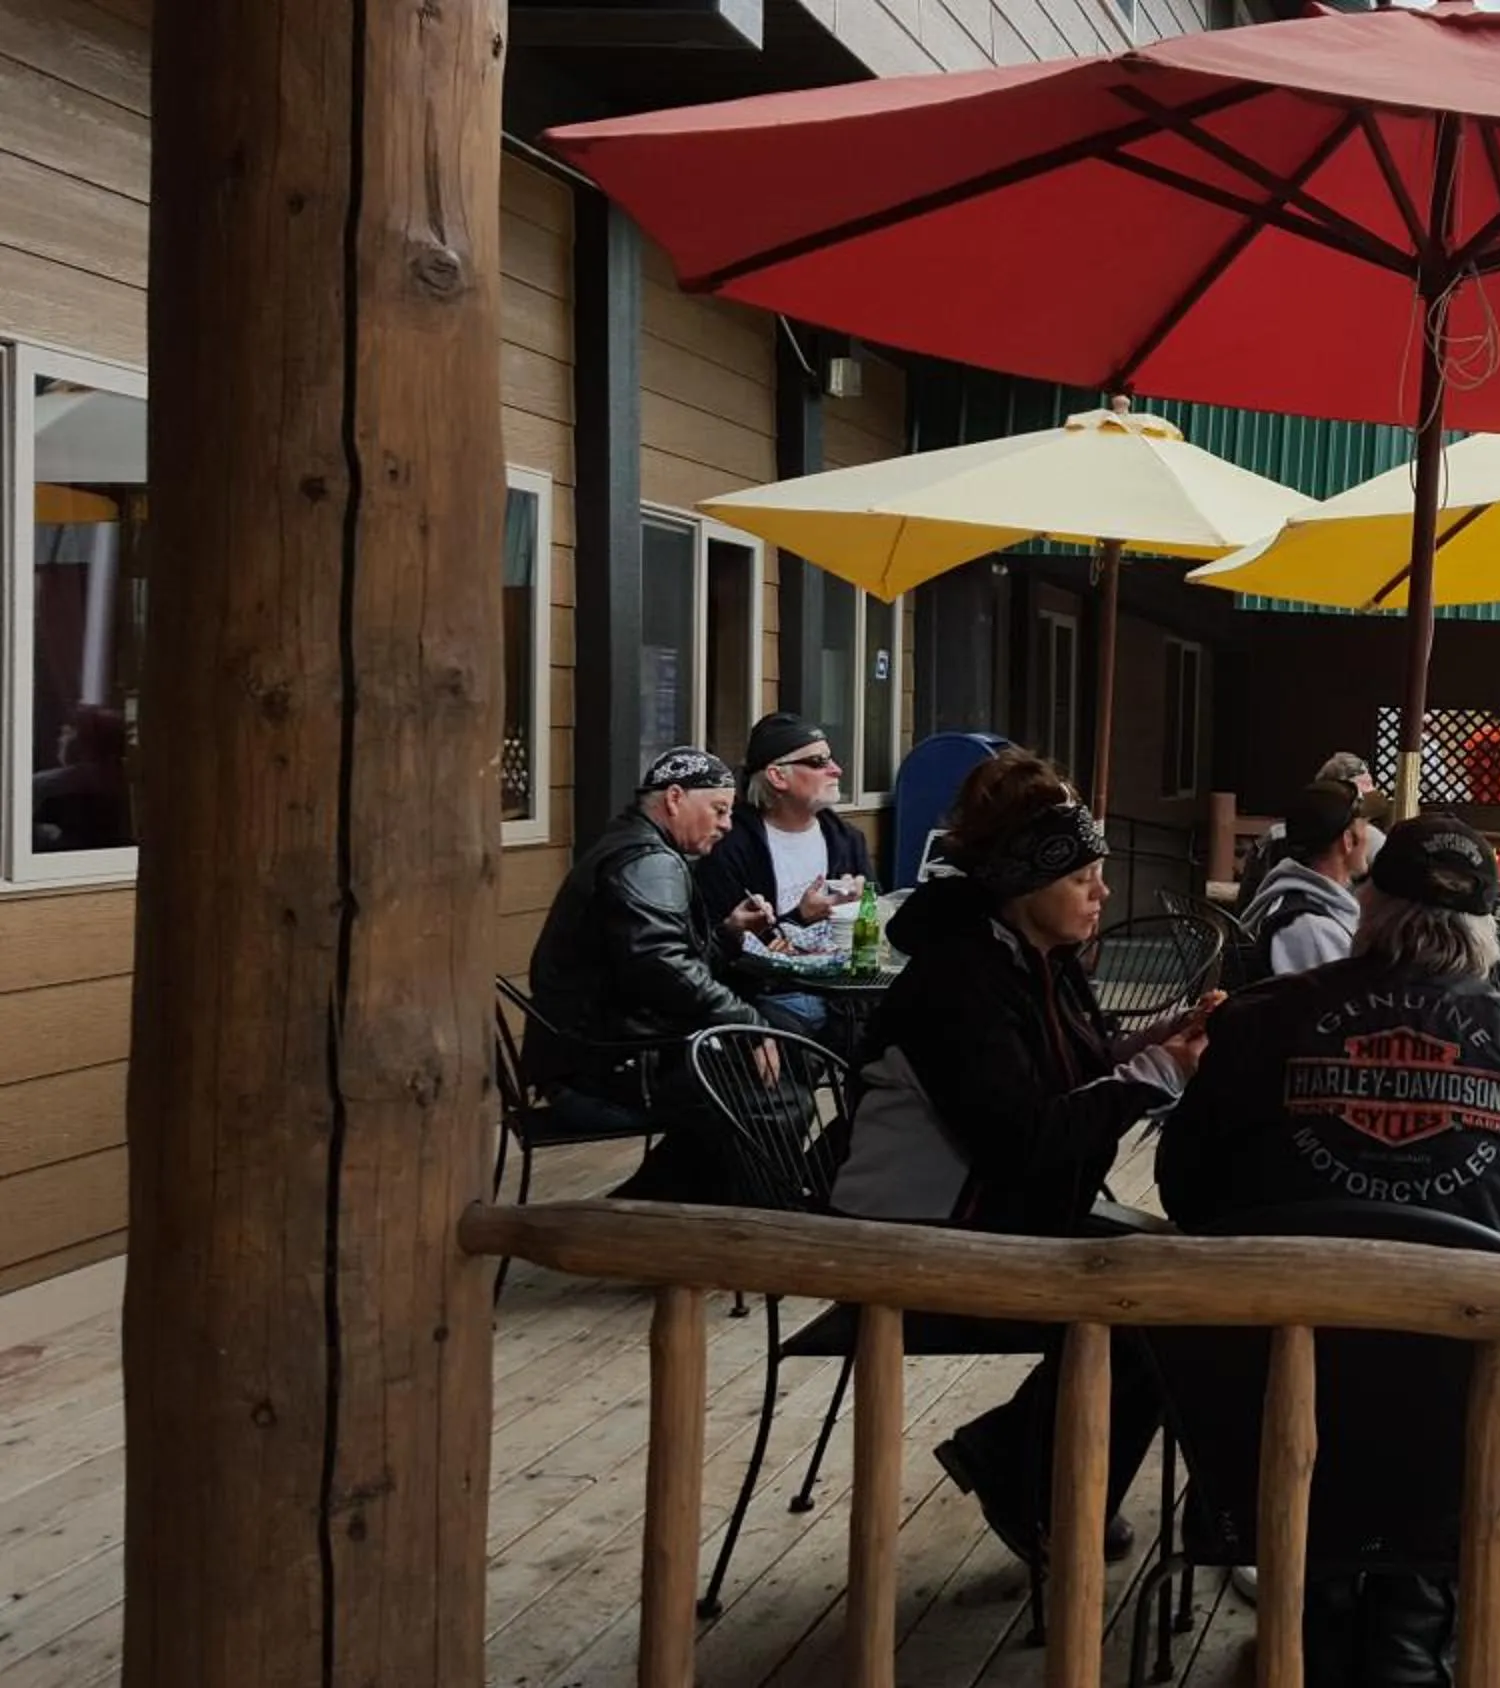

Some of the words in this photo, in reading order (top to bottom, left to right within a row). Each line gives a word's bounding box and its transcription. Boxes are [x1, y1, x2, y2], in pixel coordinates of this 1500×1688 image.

[1316, 991, 1492, 1047] GENUINE
[1356, 1035, 1446, 1061] MOTOR
[1352, 1106, 1443, 1139] CYCLES
[1292, 1126, 1498, 1202] MOTORCYCLES
